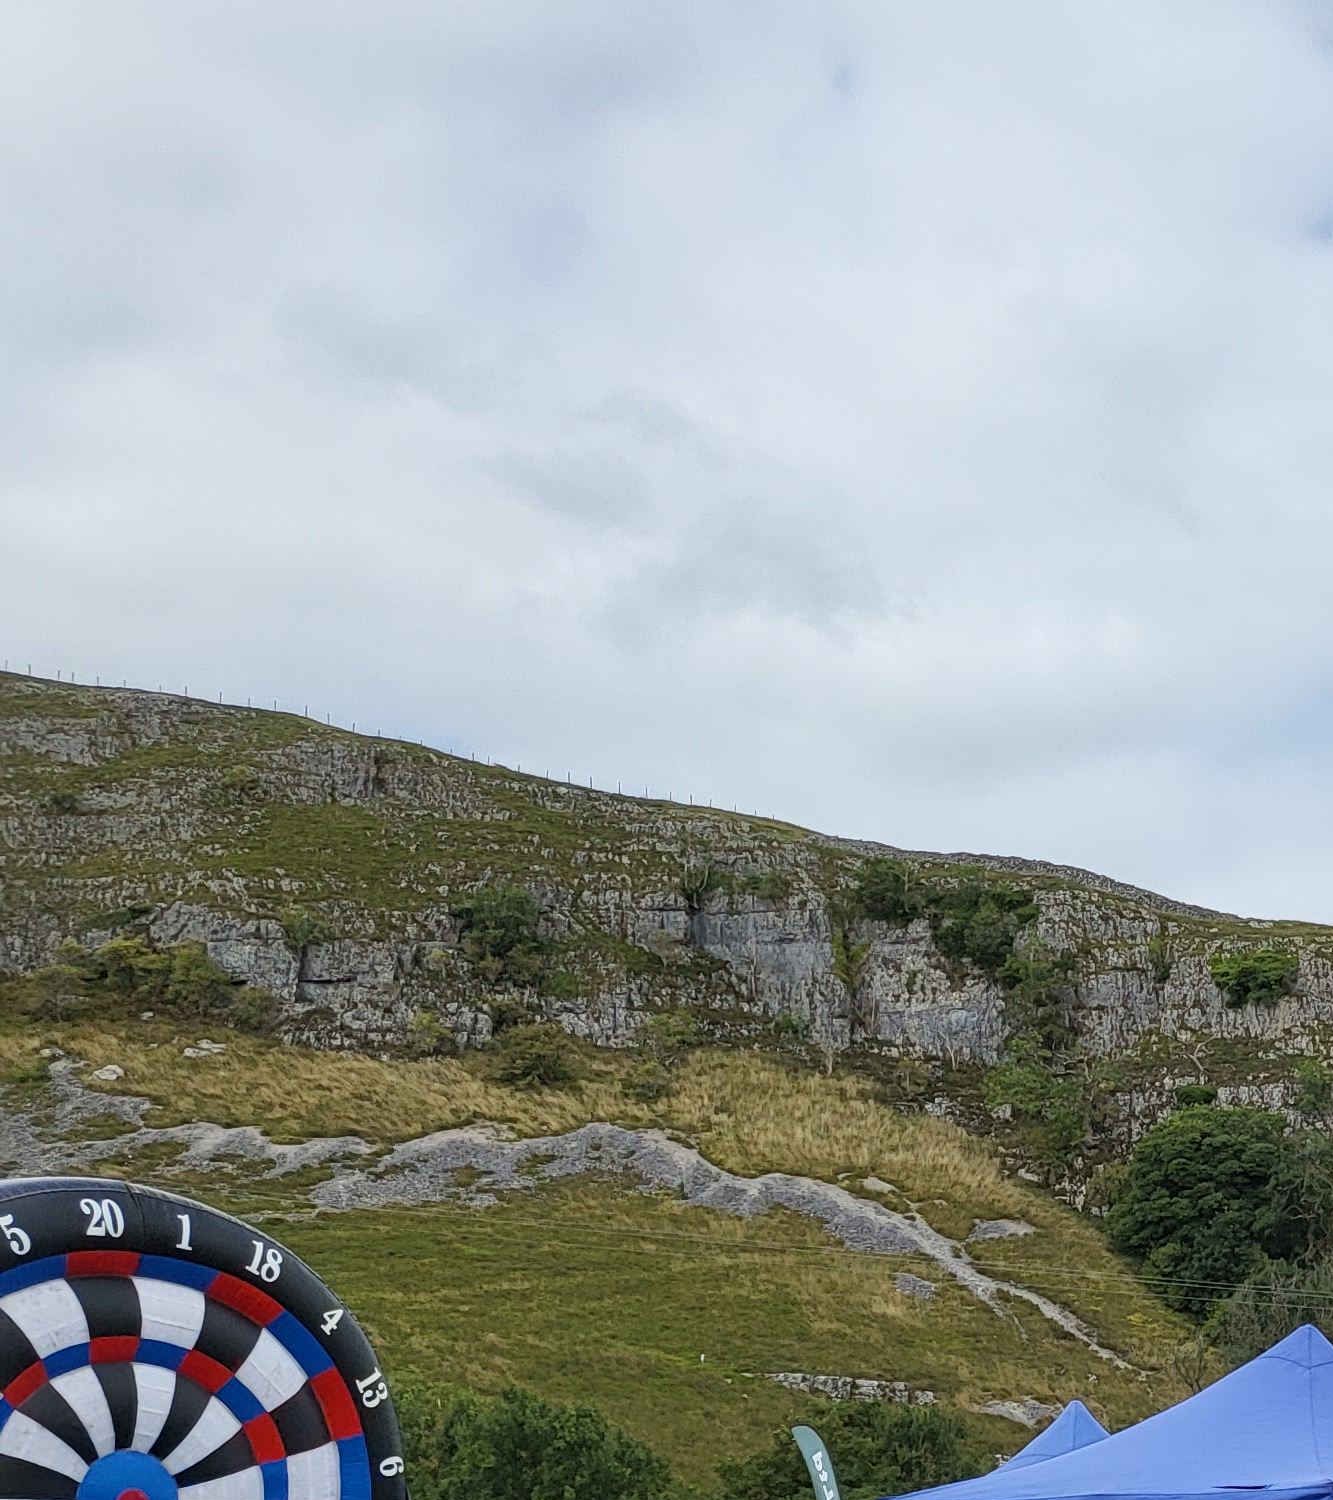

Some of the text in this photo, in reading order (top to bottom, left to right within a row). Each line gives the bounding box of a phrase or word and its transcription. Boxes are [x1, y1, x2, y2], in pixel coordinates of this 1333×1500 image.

[0, 1213, 32, 1256] 5
[80, 1198, 125, 1239] 20
[175, 1213, 193, 1251] 1
[244, 1240, 283, 1283] 18
[320, 1308, 344, 1336] 4
[355, 1366, 388, 1409] 13
[379, 1455, 405, 1477] 6
